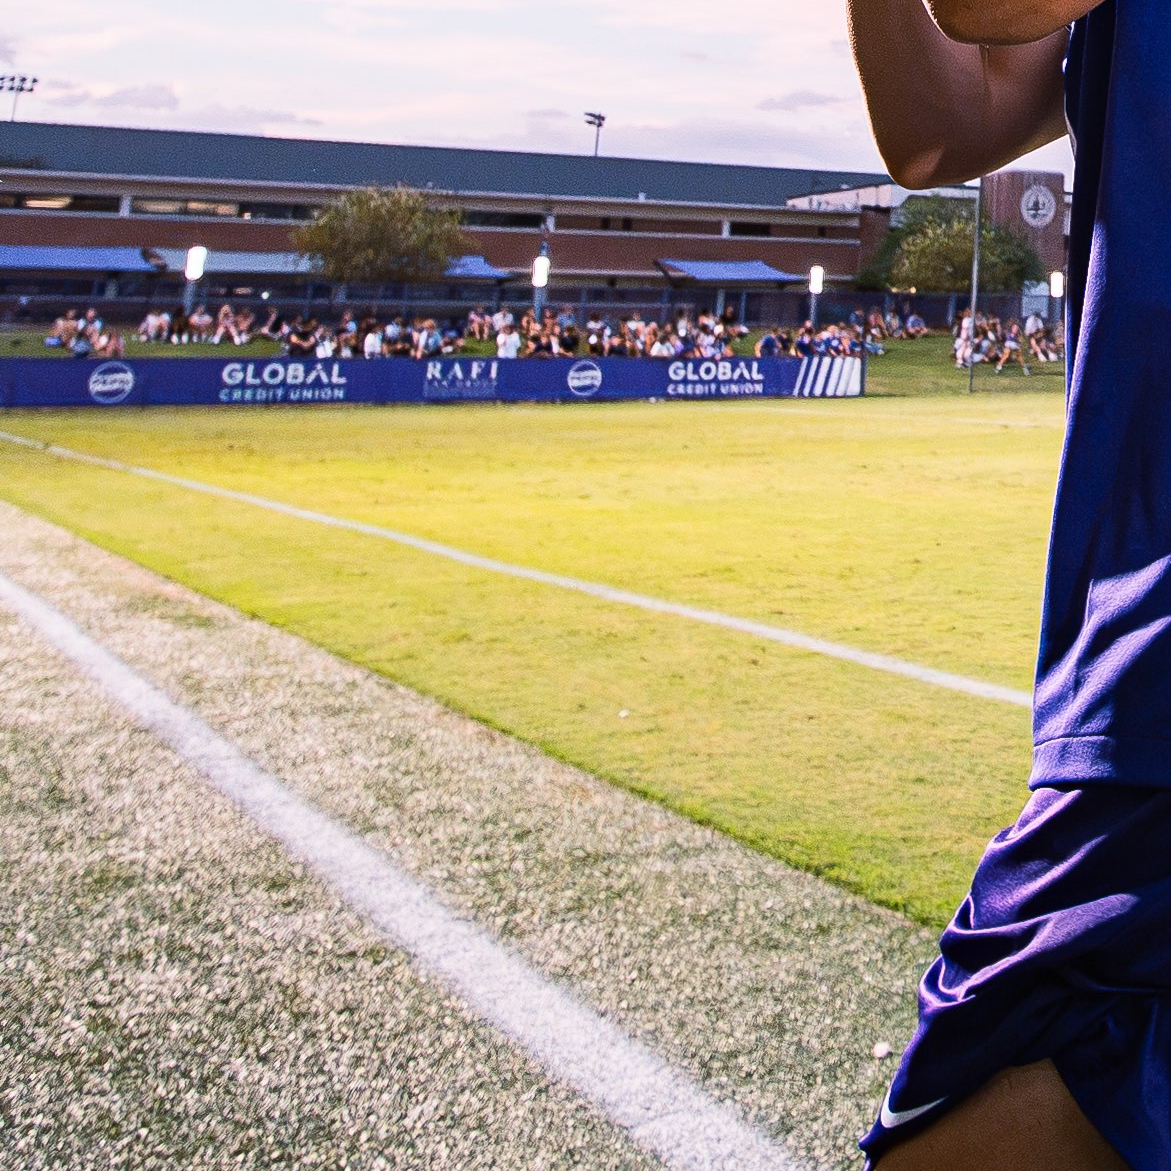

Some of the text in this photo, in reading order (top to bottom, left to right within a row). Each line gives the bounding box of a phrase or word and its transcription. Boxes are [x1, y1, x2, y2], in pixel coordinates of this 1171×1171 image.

[221, 362, 347, 385] GLOBAL
[426, 360, 499, 380] RAFI
[668, 361, 764, 381] GLOBAL
[218, 388, 345, 402] CREDIT UNION
[667, 382, 764, 395] CREDIT UNION
